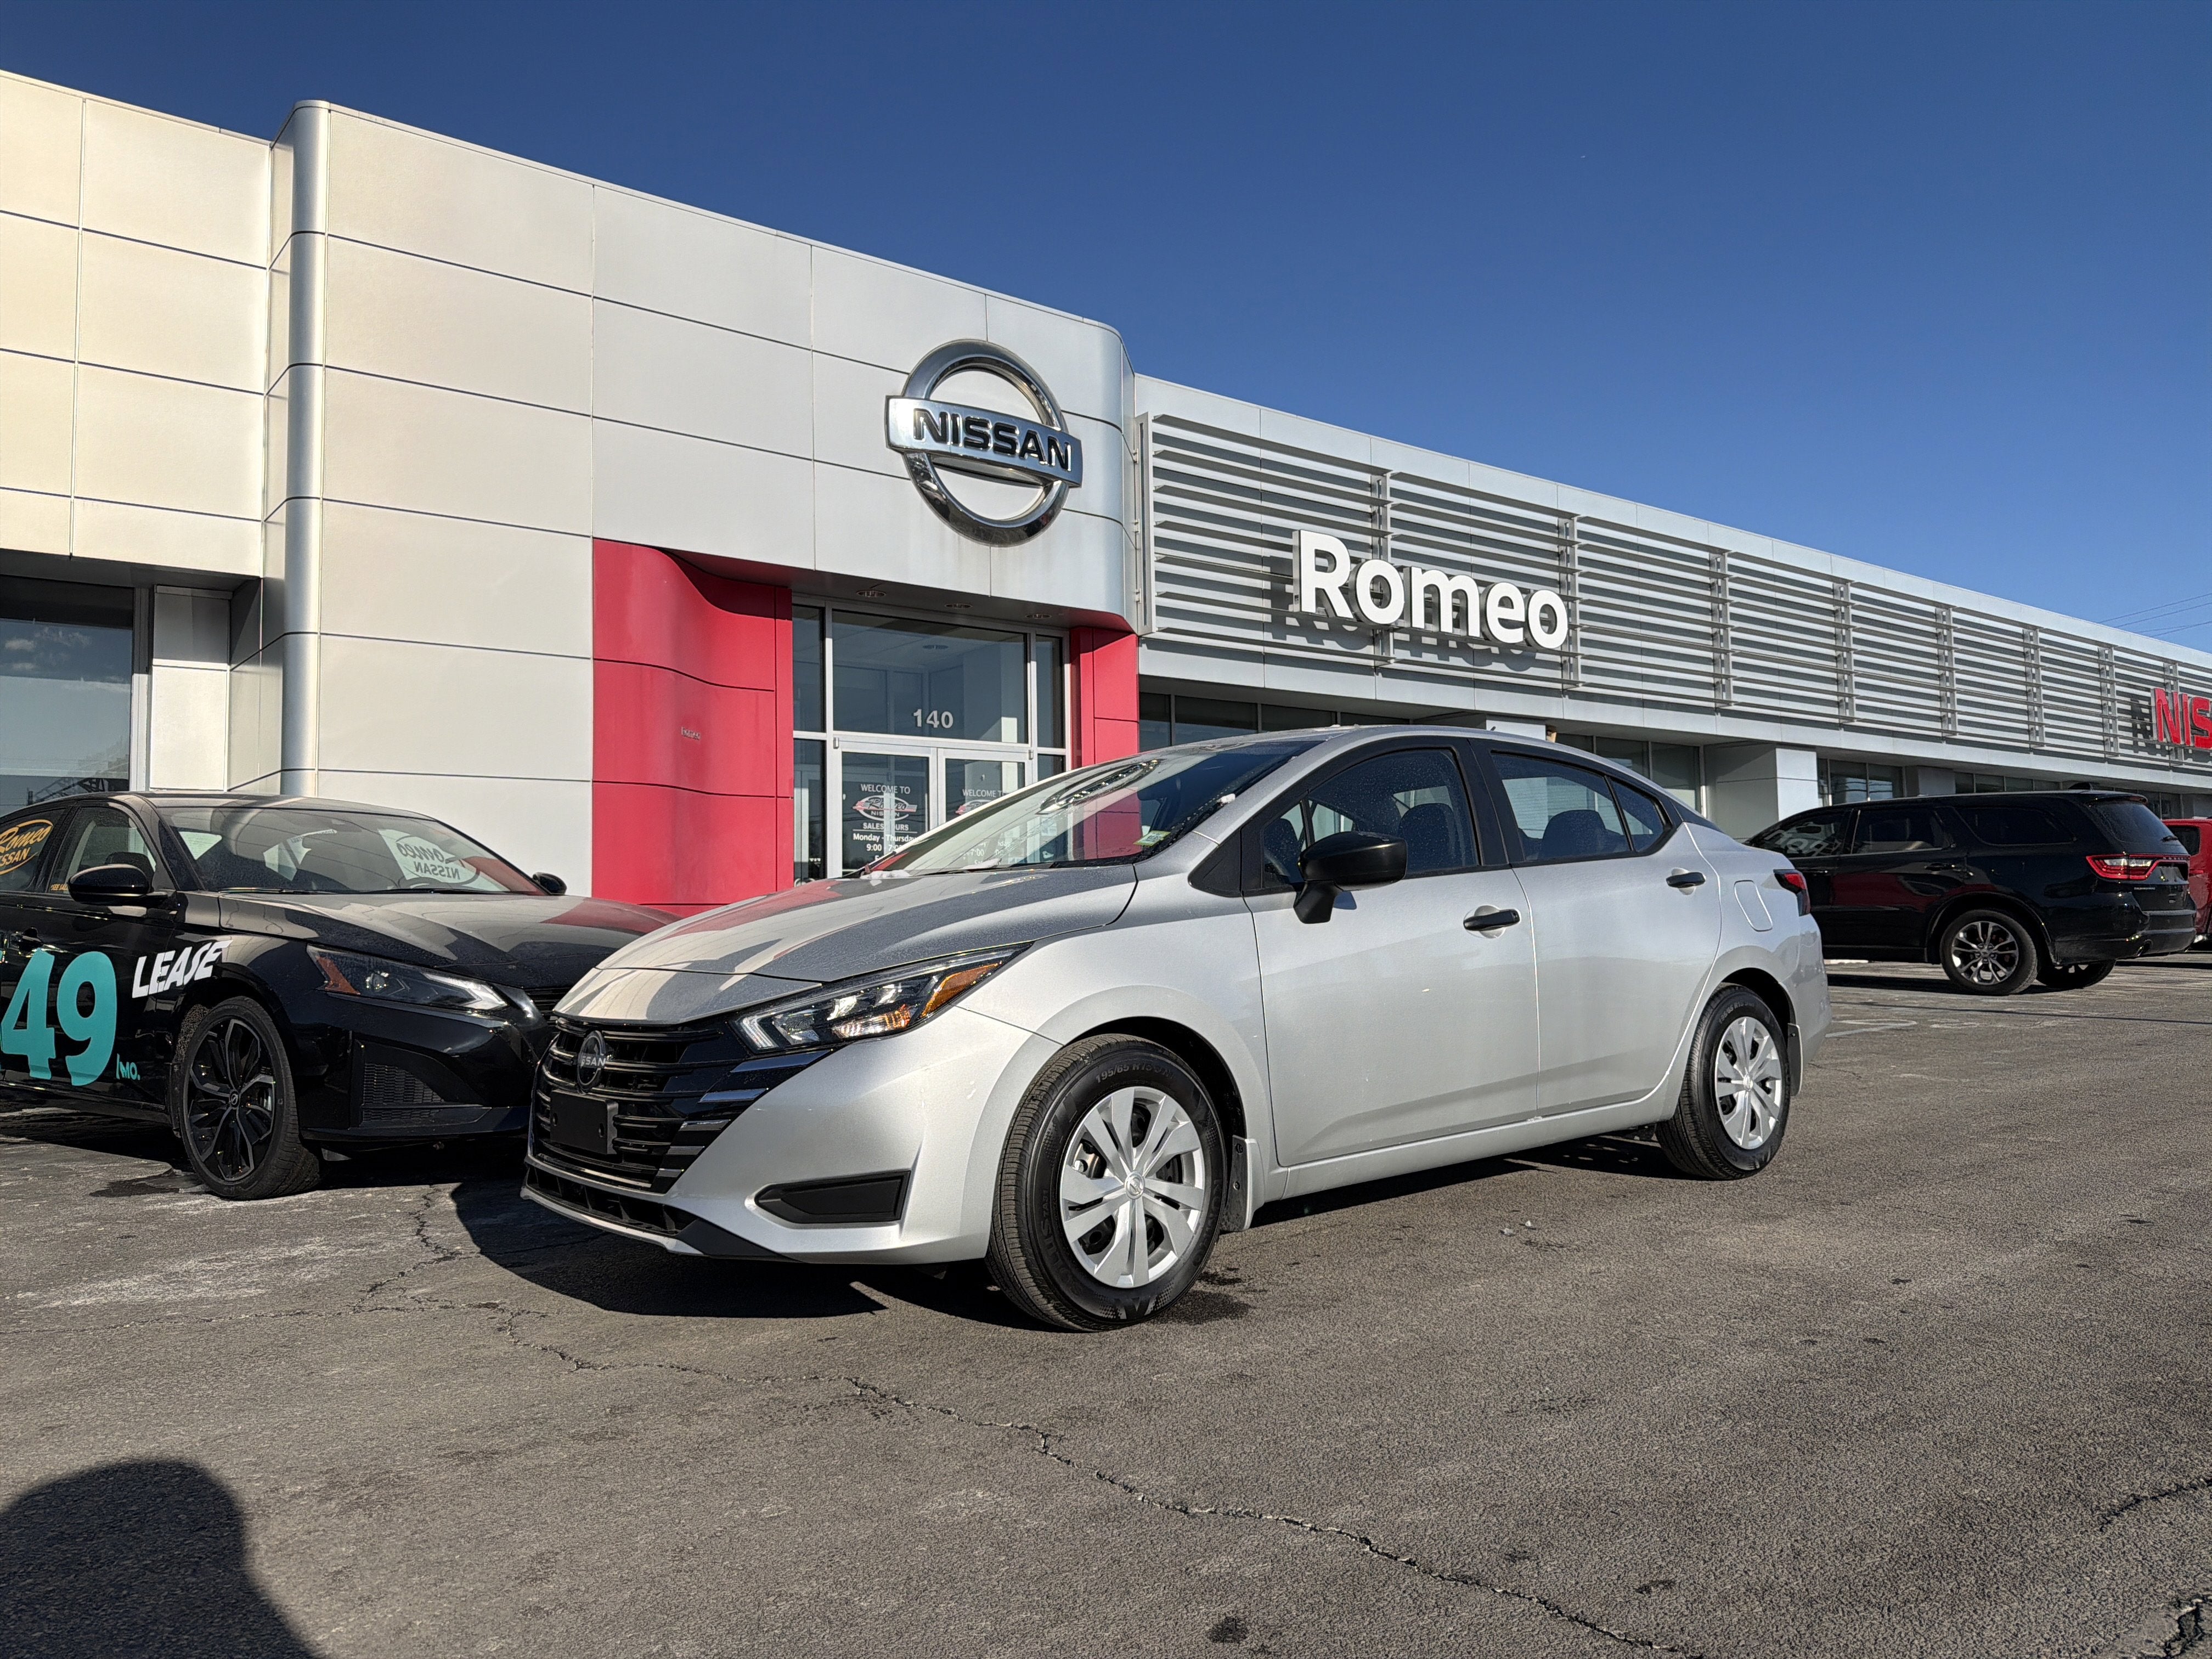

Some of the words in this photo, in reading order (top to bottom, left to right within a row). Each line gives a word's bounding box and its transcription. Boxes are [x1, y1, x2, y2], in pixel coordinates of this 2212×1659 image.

[913, 408, 1072, 472] NISSAN
[1293, 530, 1568, 649] Romeo
[913, 709, 953, 729] 140
[860, 784, 898, 794] WELCOME
[900, 786, 911, 794] TO
[962, 789, 997, 797] WELCOME
[866, 797, 907, 810] Roeo
[853, 833, 881, 843] Monday
[866, 843, 882, 851] 9:00
[132, 940, 234, 998] LEASE
[0, 947, 117, 1086] 49
[1096, 1064, 1129, 1083] 195/65
